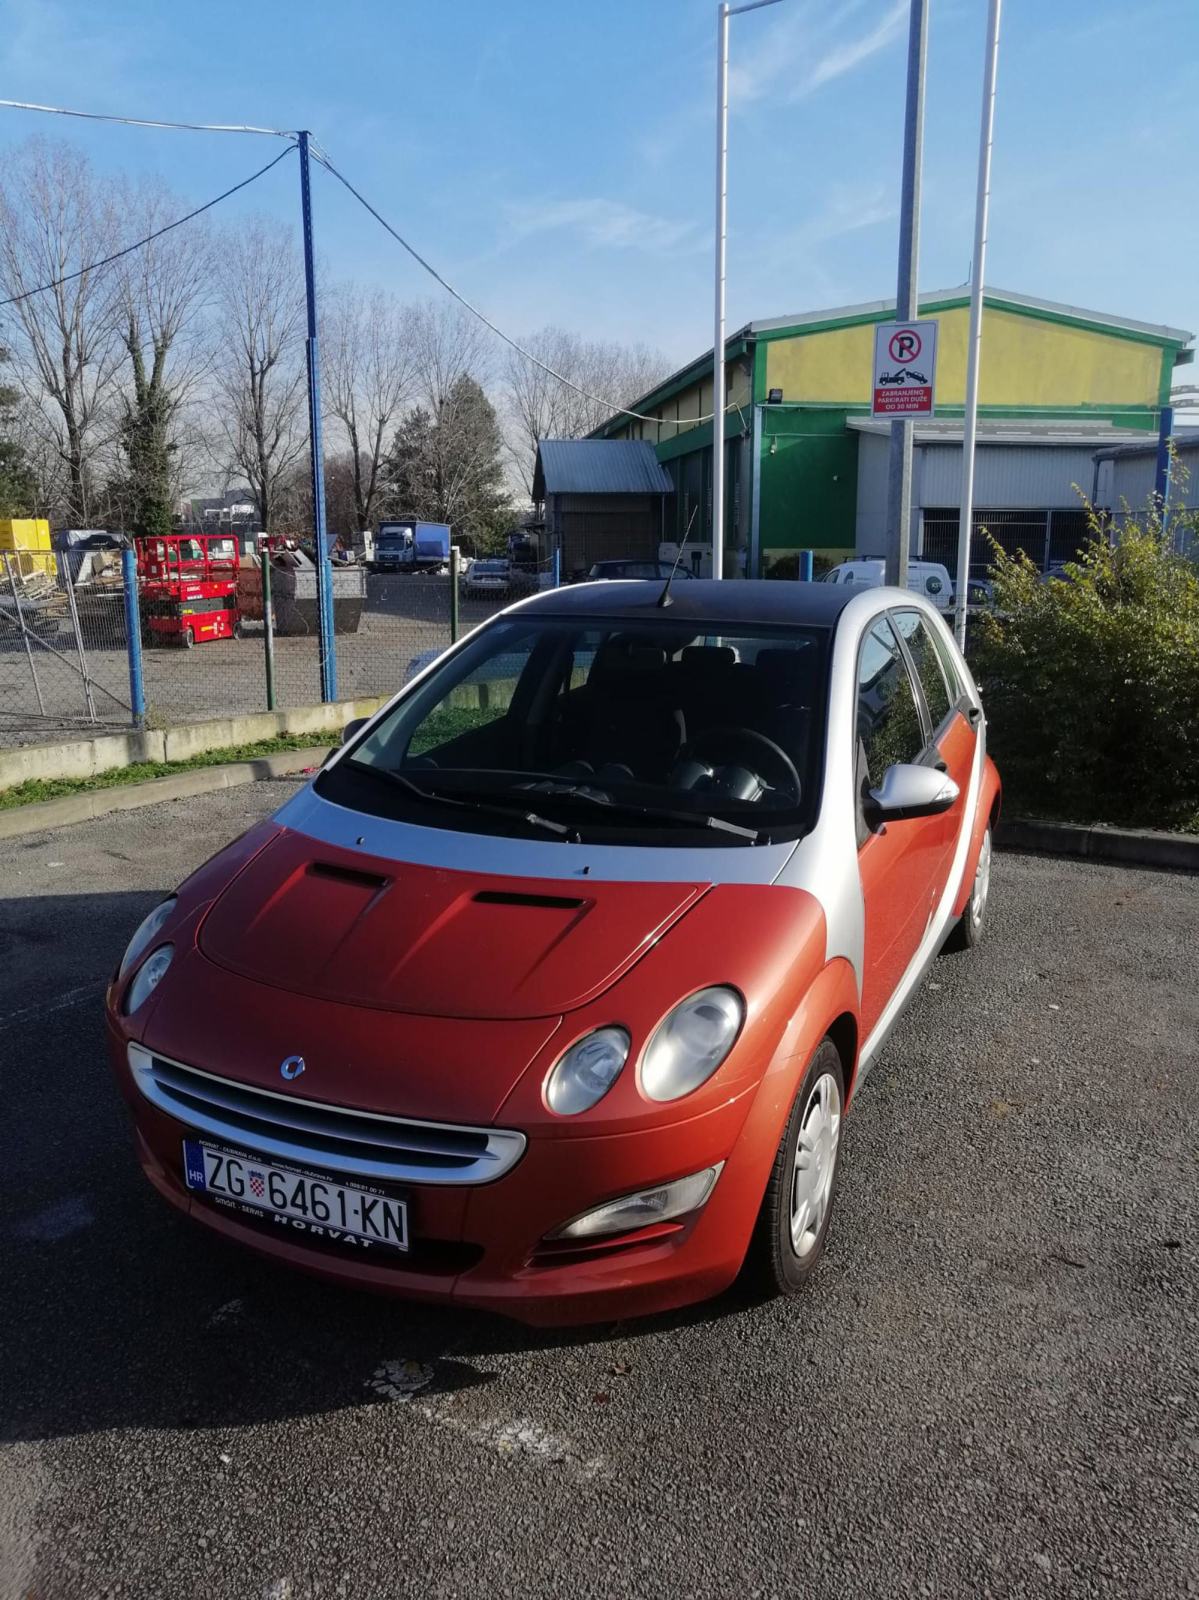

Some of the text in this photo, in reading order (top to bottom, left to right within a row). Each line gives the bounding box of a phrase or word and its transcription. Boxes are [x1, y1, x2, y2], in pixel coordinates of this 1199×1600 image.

[189, 1169, 204, 1183] HR
[207, 1152, 404, 1243] ZG 6461-KN
[274, 1214, 375, 1248] HORVAT
